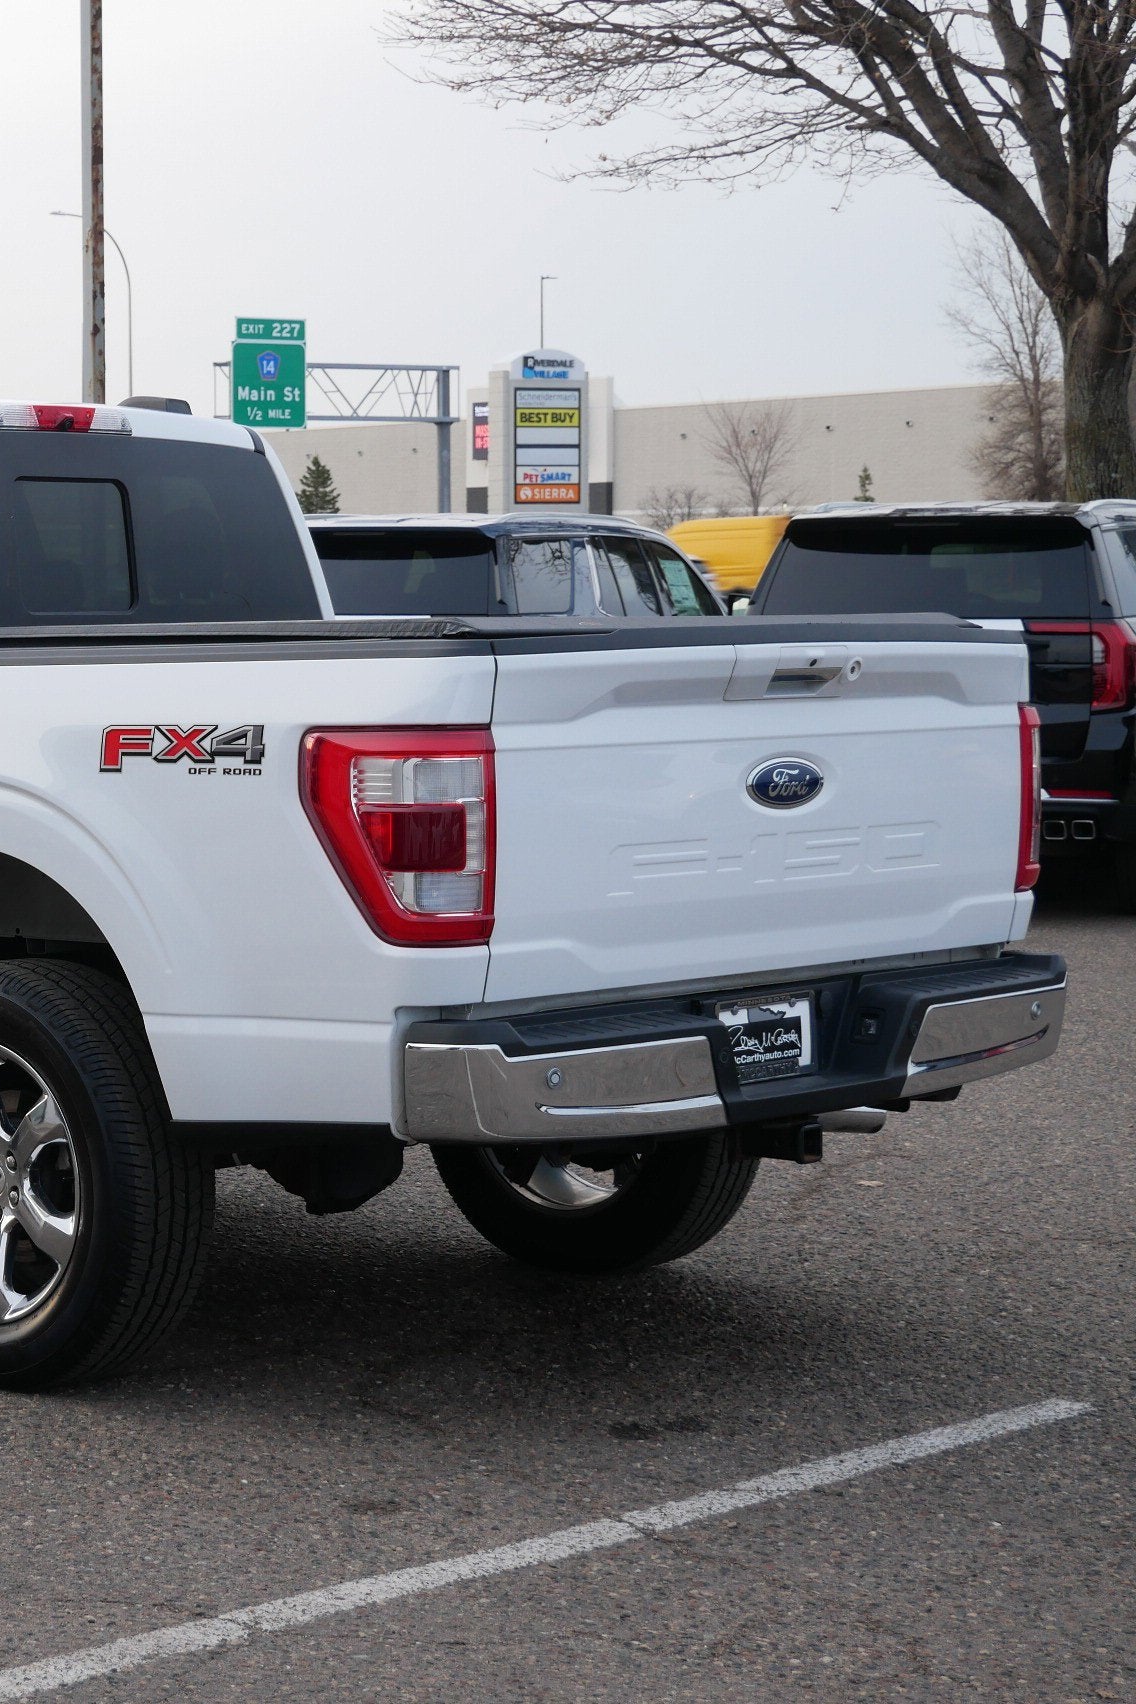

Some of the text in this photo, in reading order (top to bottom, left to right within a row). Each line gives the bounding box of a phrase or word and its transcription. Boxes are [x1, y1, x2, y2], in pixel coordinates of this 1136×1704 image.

[241, 323, 301, 337] EXIT 227
[262, 360, 275, 374] 14
[237, 386, 301, 401] Main St
[268, 409, 291, 419] MILE
[520, 412, 575, 423] BEST BUY
[533, 488, 575, 499] SIERRA
[99, 724, 265, 772] FX4
[188, 767, 262, 776] OFF ROAD
[768, 768, 810, 798] Ford
